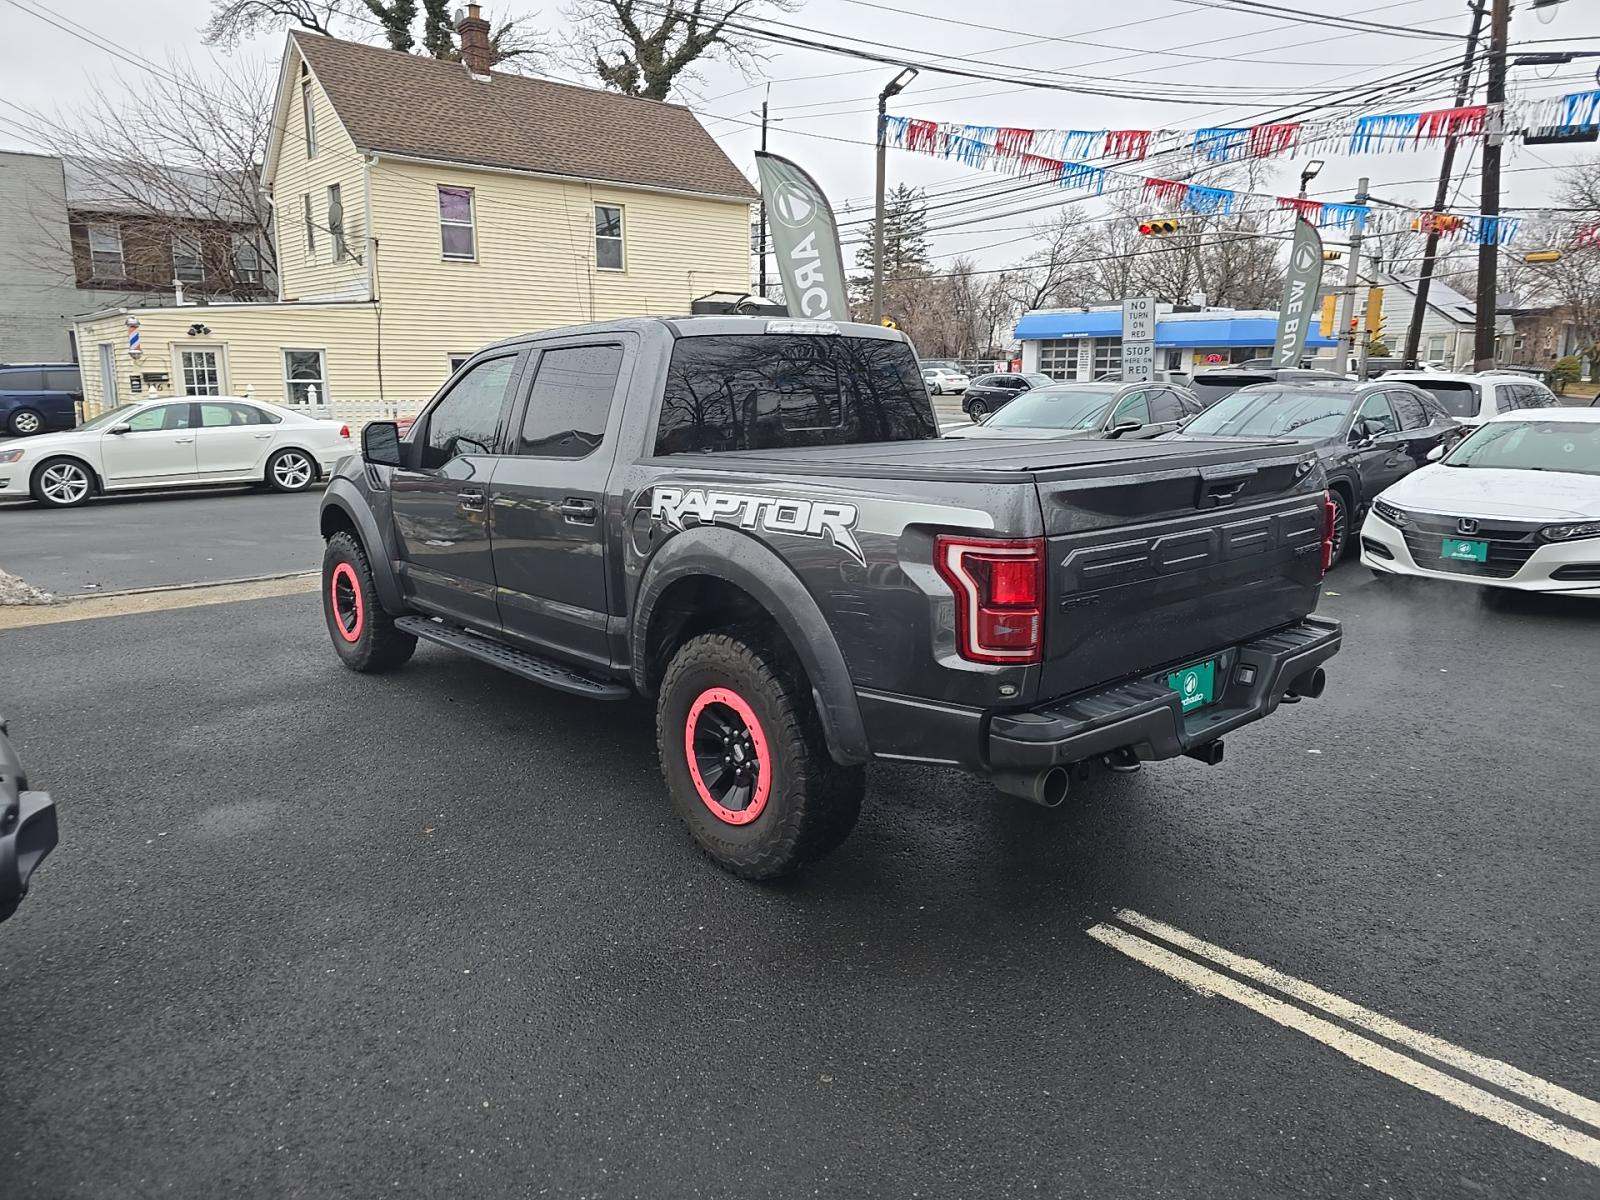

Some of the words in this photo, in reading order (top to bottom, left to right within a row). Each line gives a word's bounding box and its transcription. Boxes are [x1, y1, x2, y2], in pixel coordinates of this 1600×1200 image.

[1131, 301, 1146, 310] NO
[1129, 312, 1148, 320] TURN
[1133, 321, 1144, 329] ON
[1126, 346, 1151, 356] STOP
[1128, 366, 1148, 375] RED
[651, 487, 867, 568] RAPTOR
